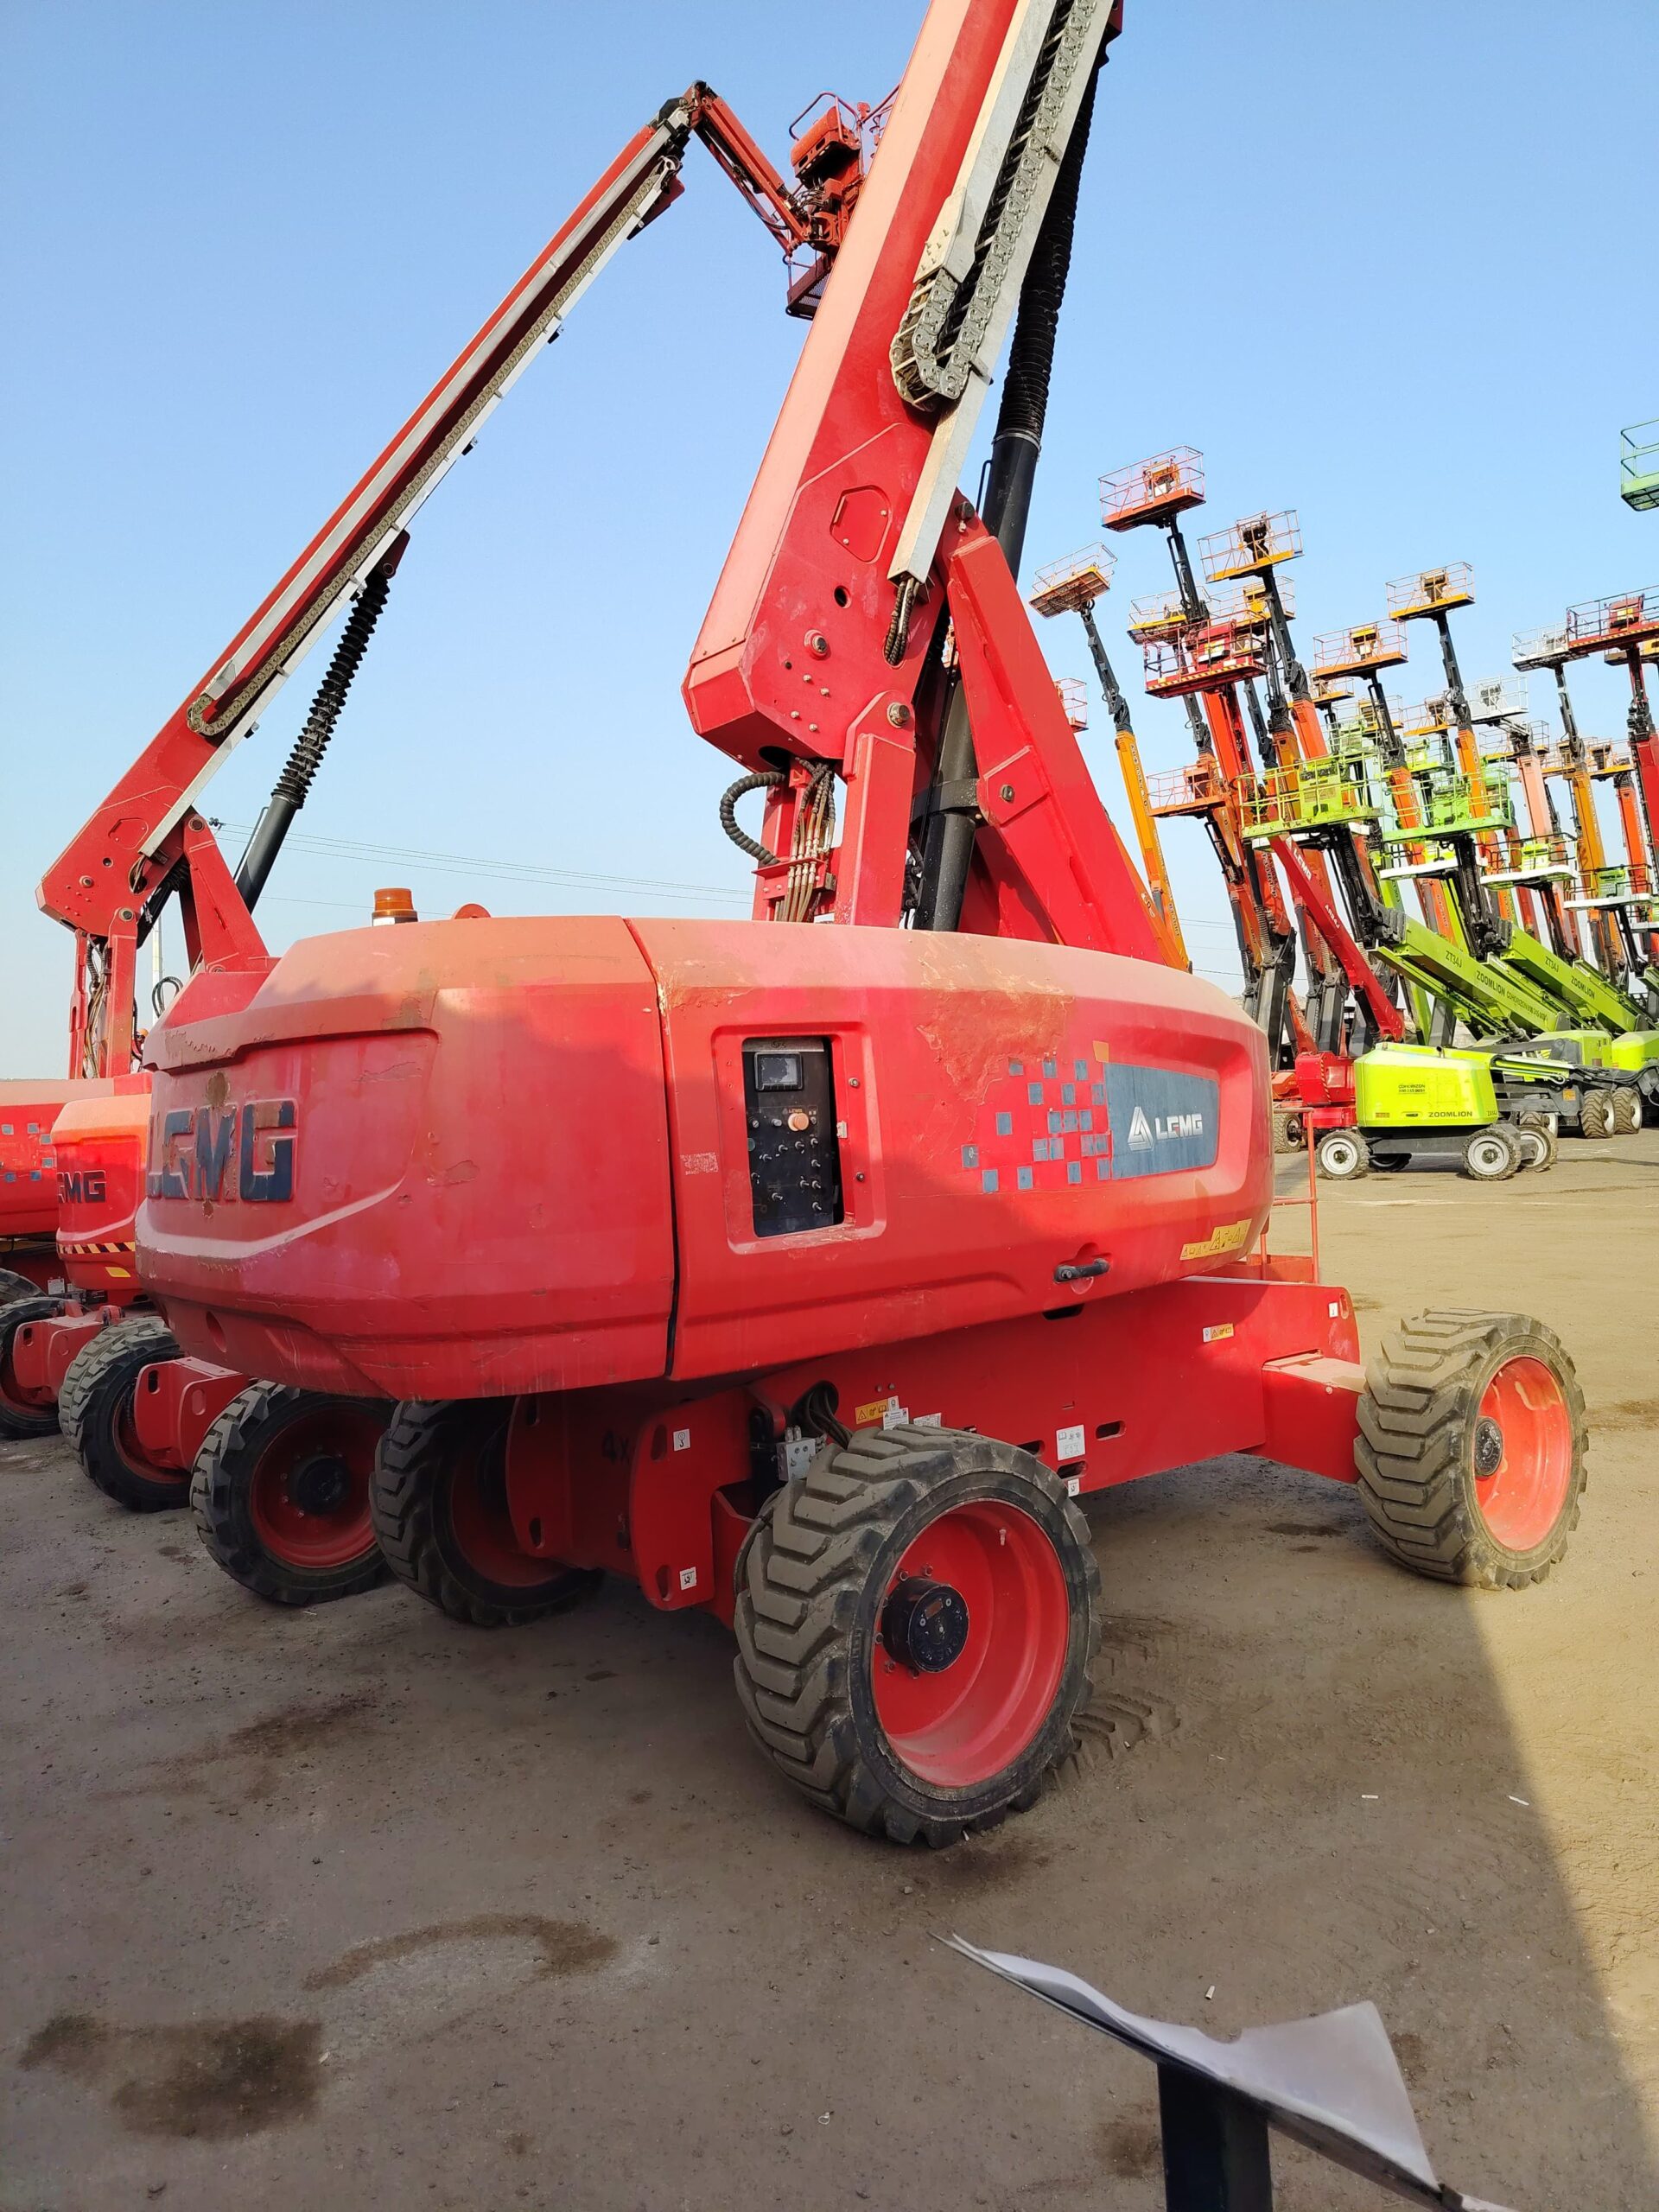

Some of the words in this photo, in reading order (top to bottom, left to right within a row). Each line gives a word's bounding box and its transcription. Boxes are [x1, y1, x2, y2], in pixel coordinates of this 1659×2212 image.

[1446, 950, 1463, 968] ZT34J
[1476, 969, 1506, 997] ZOOMLION
[1571, 976, 1595, 1001] ZOOMLION
[1155, 1113, 1204, 1141] LGMG
